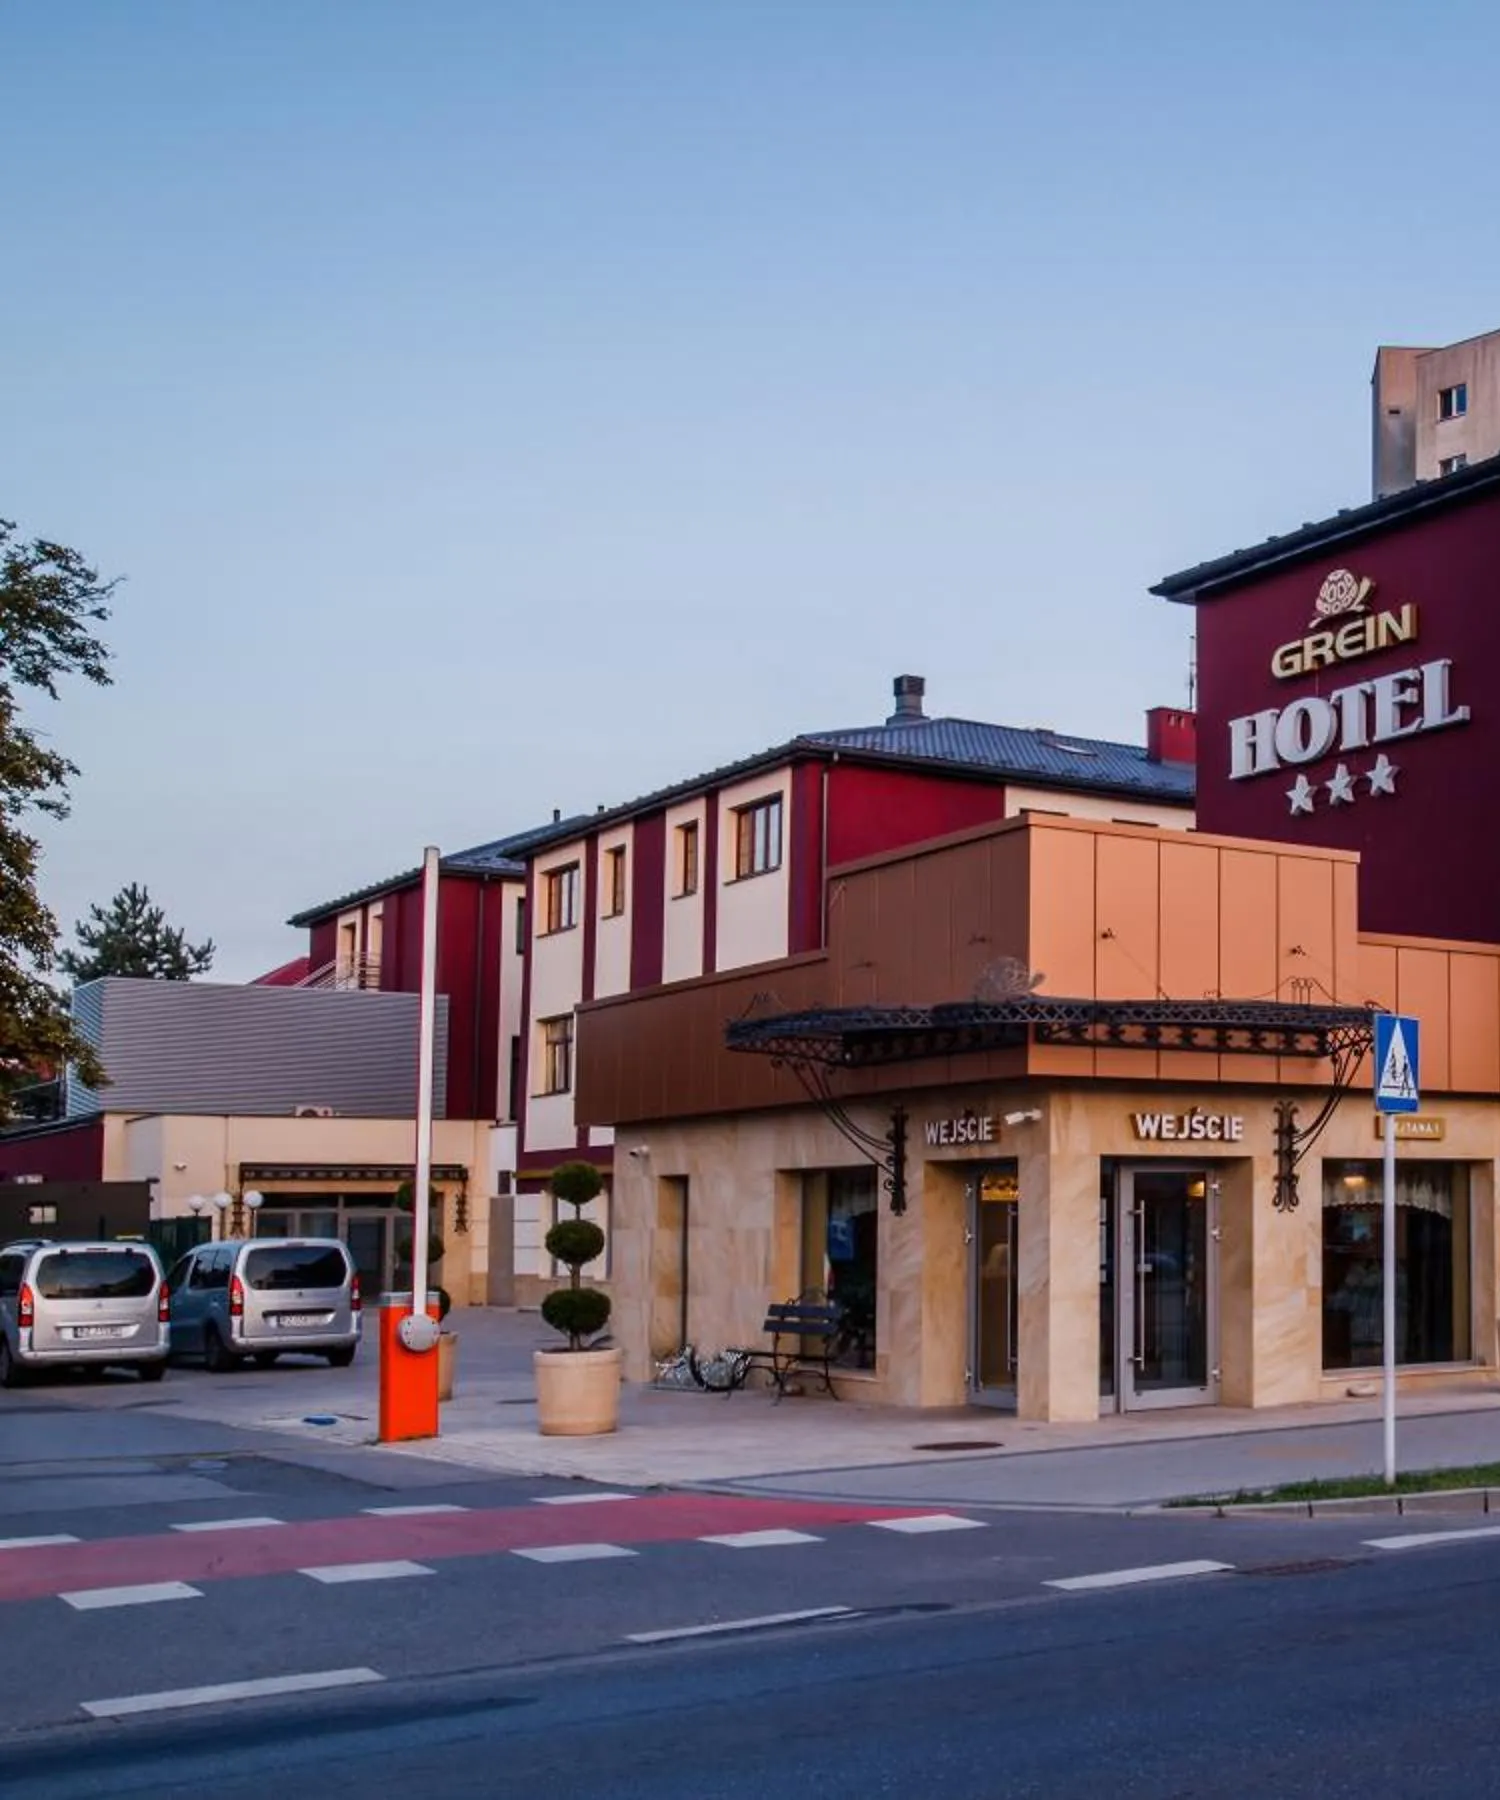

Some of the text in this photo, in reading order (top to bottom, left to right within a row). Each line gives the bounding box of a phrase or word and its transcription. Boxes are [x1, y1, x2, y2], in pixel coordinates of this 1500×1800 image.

[1271, 602, 1418, 679] GREIN
[1229, 658, 1471, 780] HOTEL
[924, 1110, 994, 1145] WEJŚCIE
[1132, 1106, 1243, 1141] WEJŚCIE
